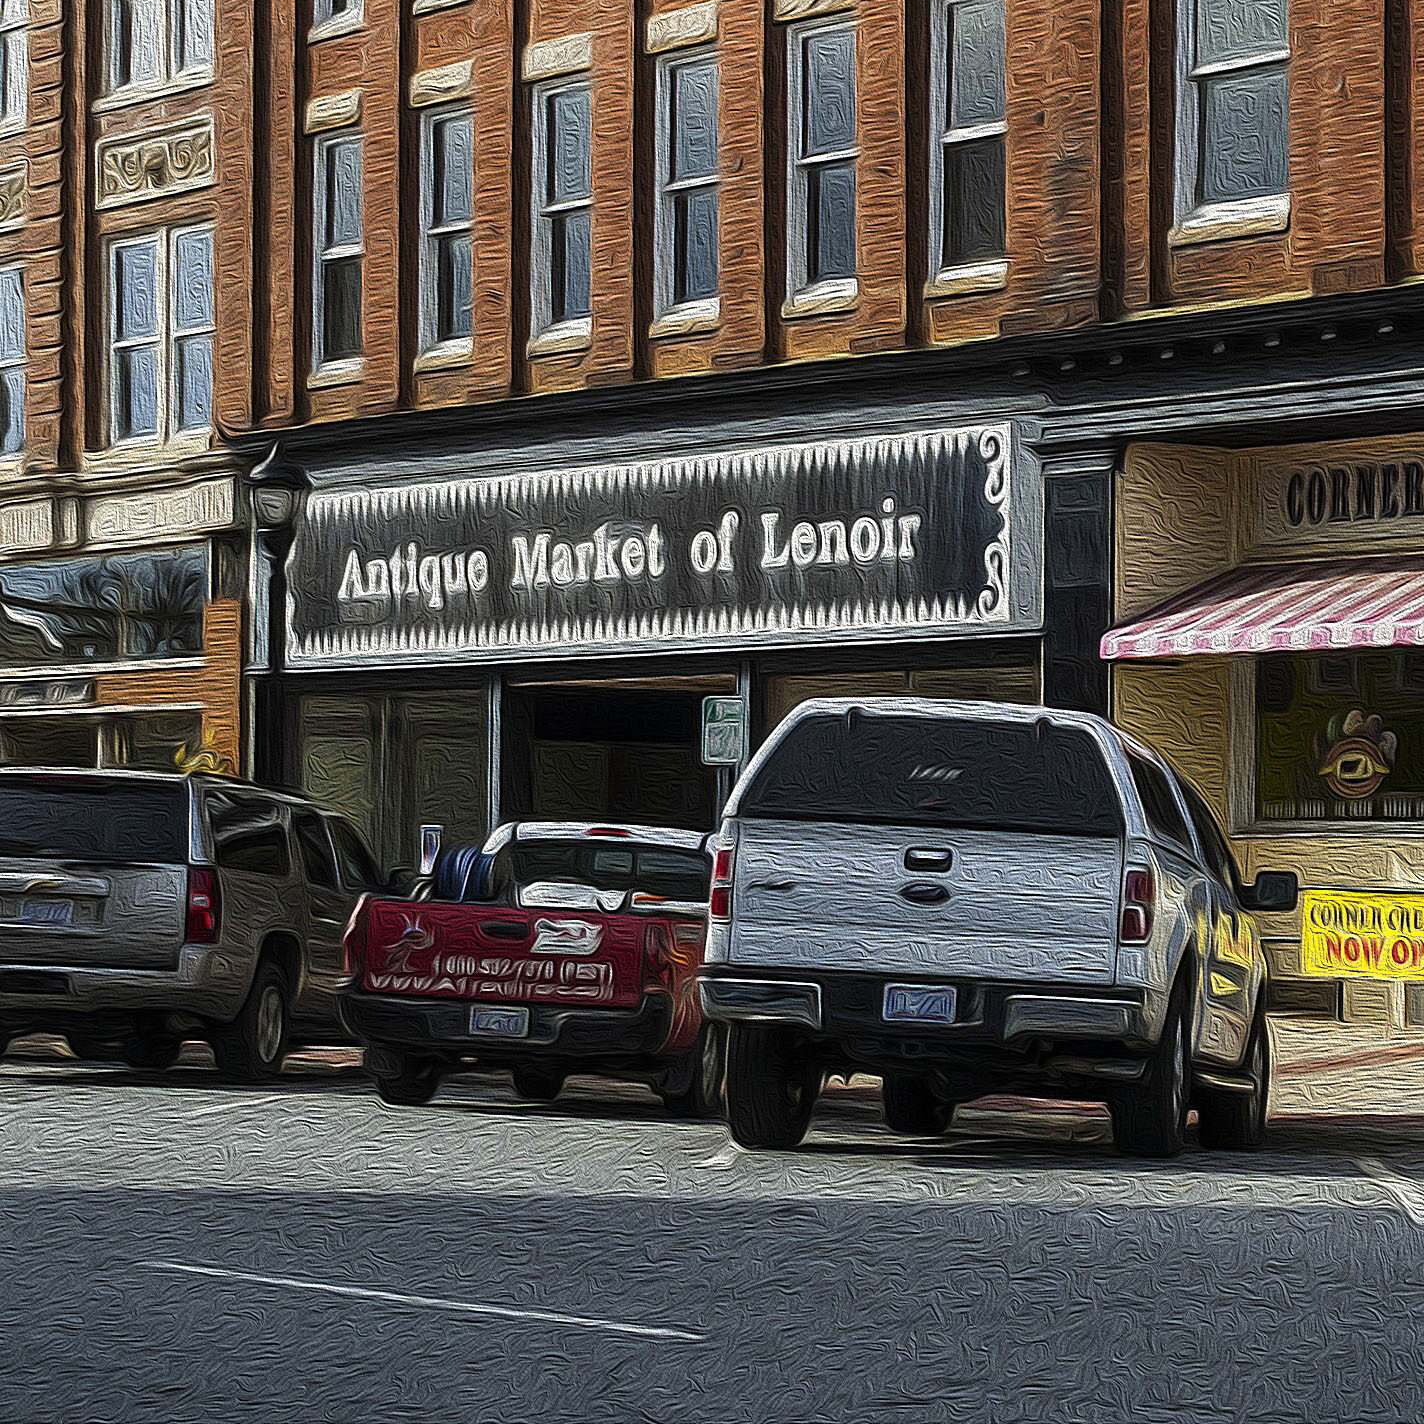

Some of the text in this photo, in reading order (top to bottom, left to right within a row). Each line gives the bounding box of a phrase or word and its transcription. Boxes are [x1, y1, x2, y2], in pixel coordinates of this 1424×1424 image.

[1284, 460, 1424, 526] CORNER
[338, 497, 921, 610] Antique Market of Lenoir
[1326, 934, 1386, 966] NOW
